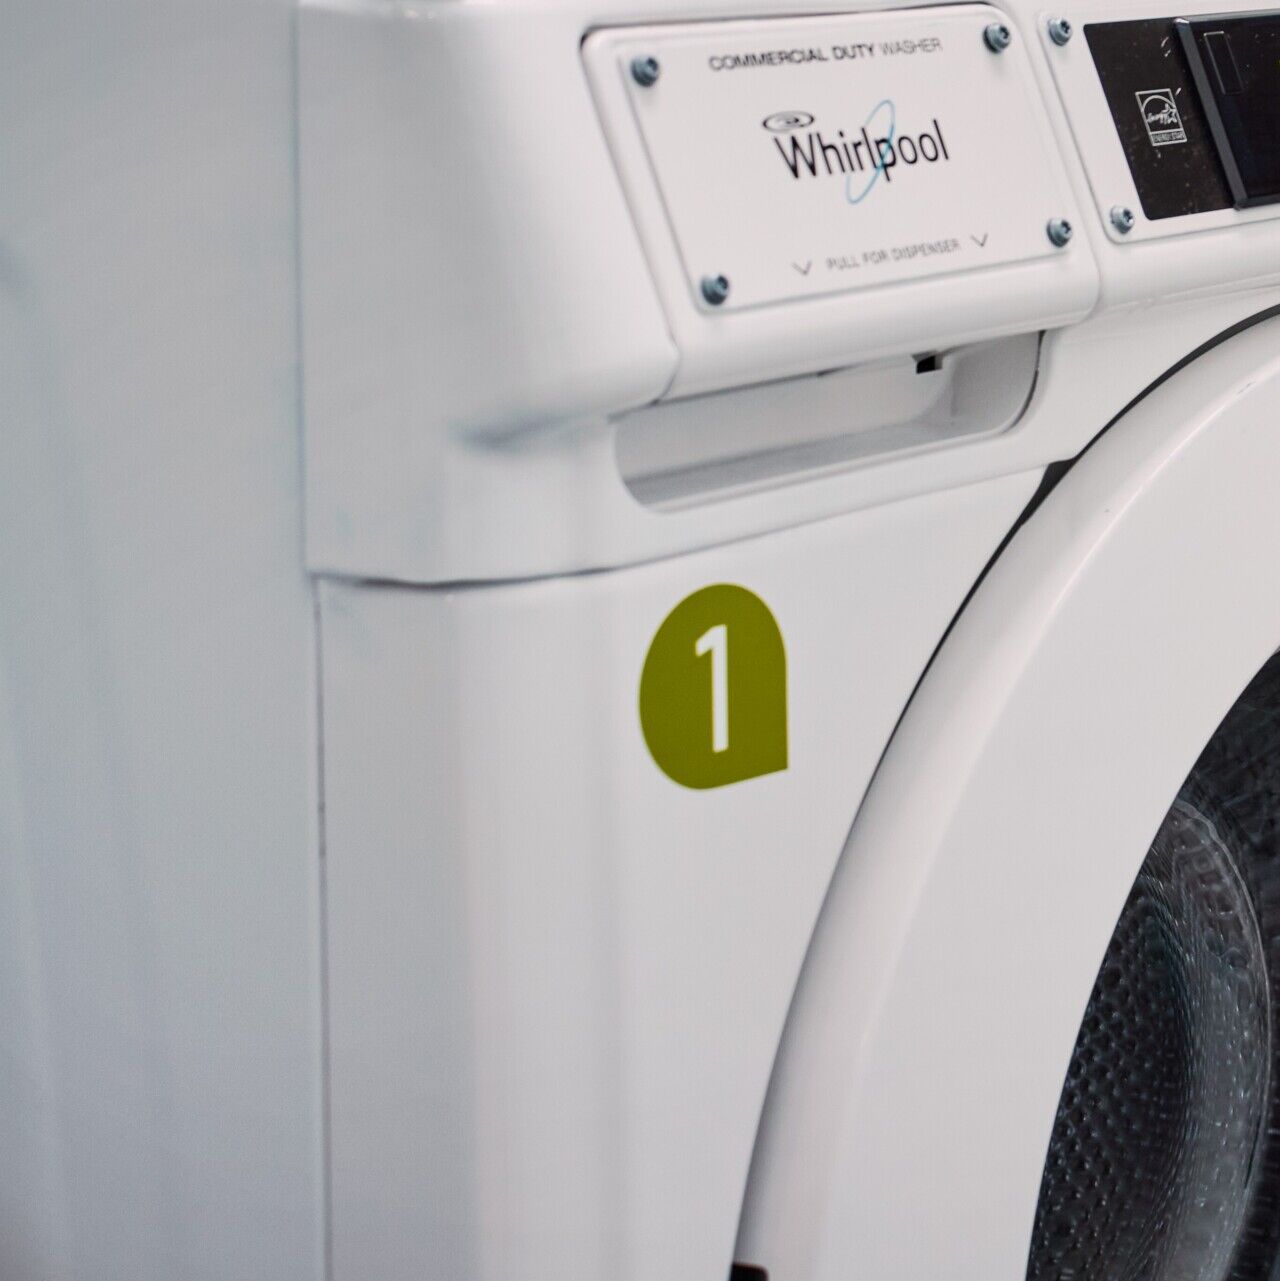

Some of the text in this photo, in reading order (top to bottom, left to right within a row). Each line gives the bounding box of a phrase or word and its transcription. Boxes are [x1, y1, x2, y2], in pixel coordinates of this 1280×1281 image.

[708, 37, 944, 71] COMMERCIAL DUTY WASHER
[774, 119, 949, 182] Whirlpool
[825, 238, 960, 271] PULL FOR DISPENSER
[695, 623, 729, 754] 1
